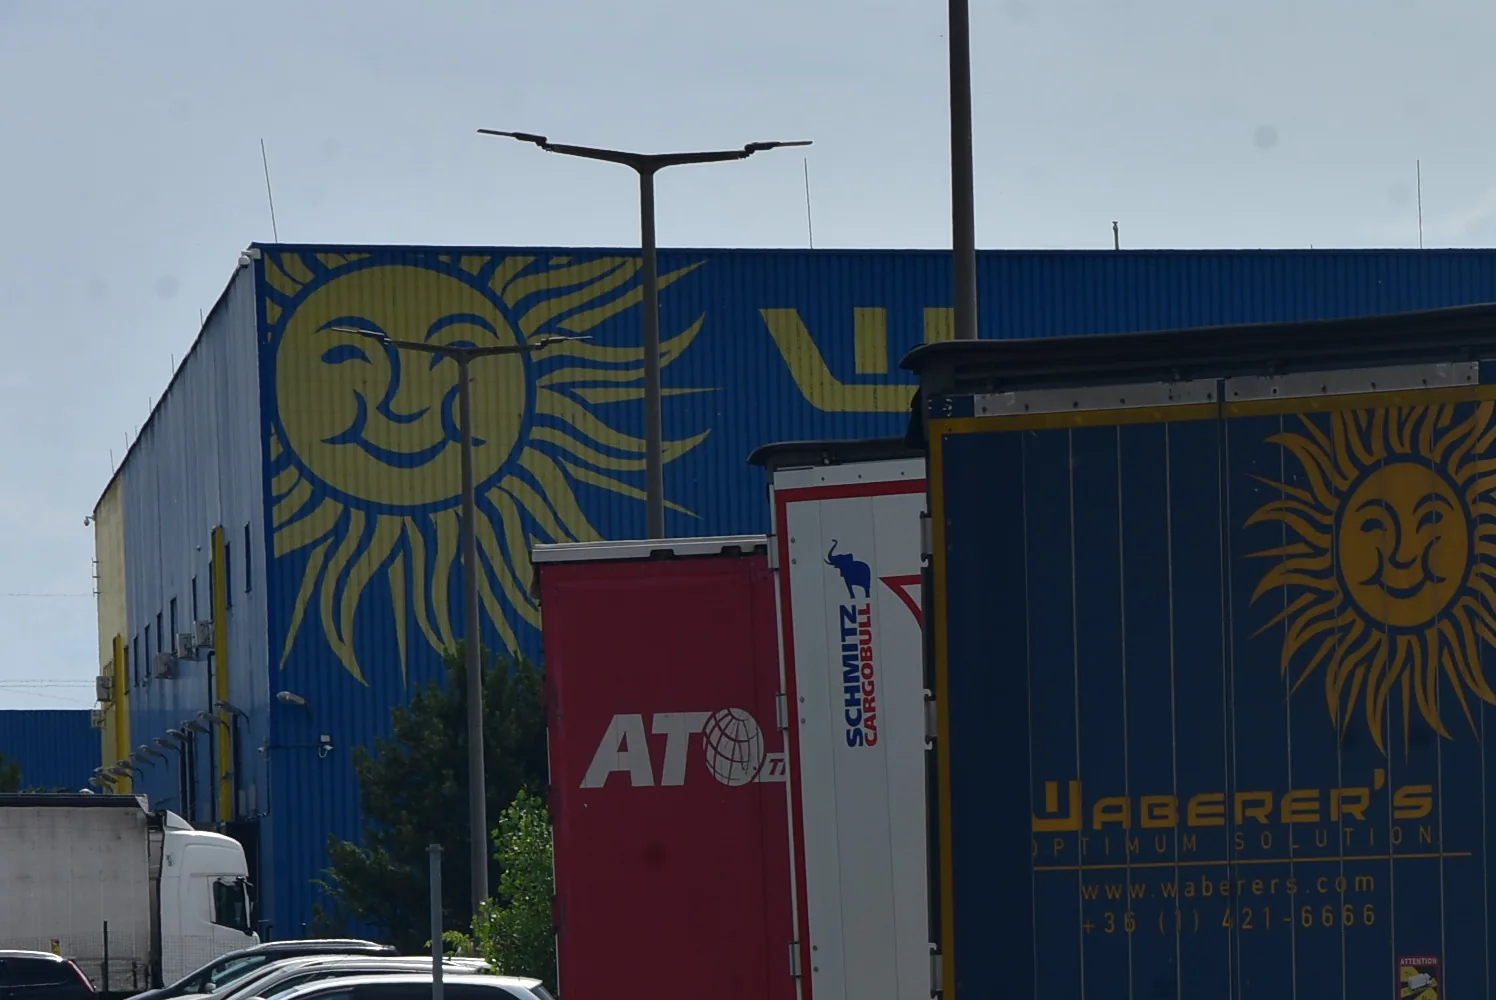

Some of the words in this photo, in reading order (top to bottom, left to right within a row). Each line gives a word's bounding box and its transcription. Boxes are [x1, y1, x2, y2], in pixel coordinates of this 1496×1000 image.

[840, 605, 863, 747] SCHMITZ
[858, 603, 877, 746] CARGOBULL
[1032, 769, 1432, 831] WABERER'S
[1234, 825, 1432, 850] SOLUTION
[1082, 874, 1374, 899] www.waberers.com
[1081, 911, 1135, 934] +36
[1158, 907, 1199, 936] (1)
[1221, 904, 1375, 930] 421-6666
[1400, 957, 1437, 965] ATTENTION
